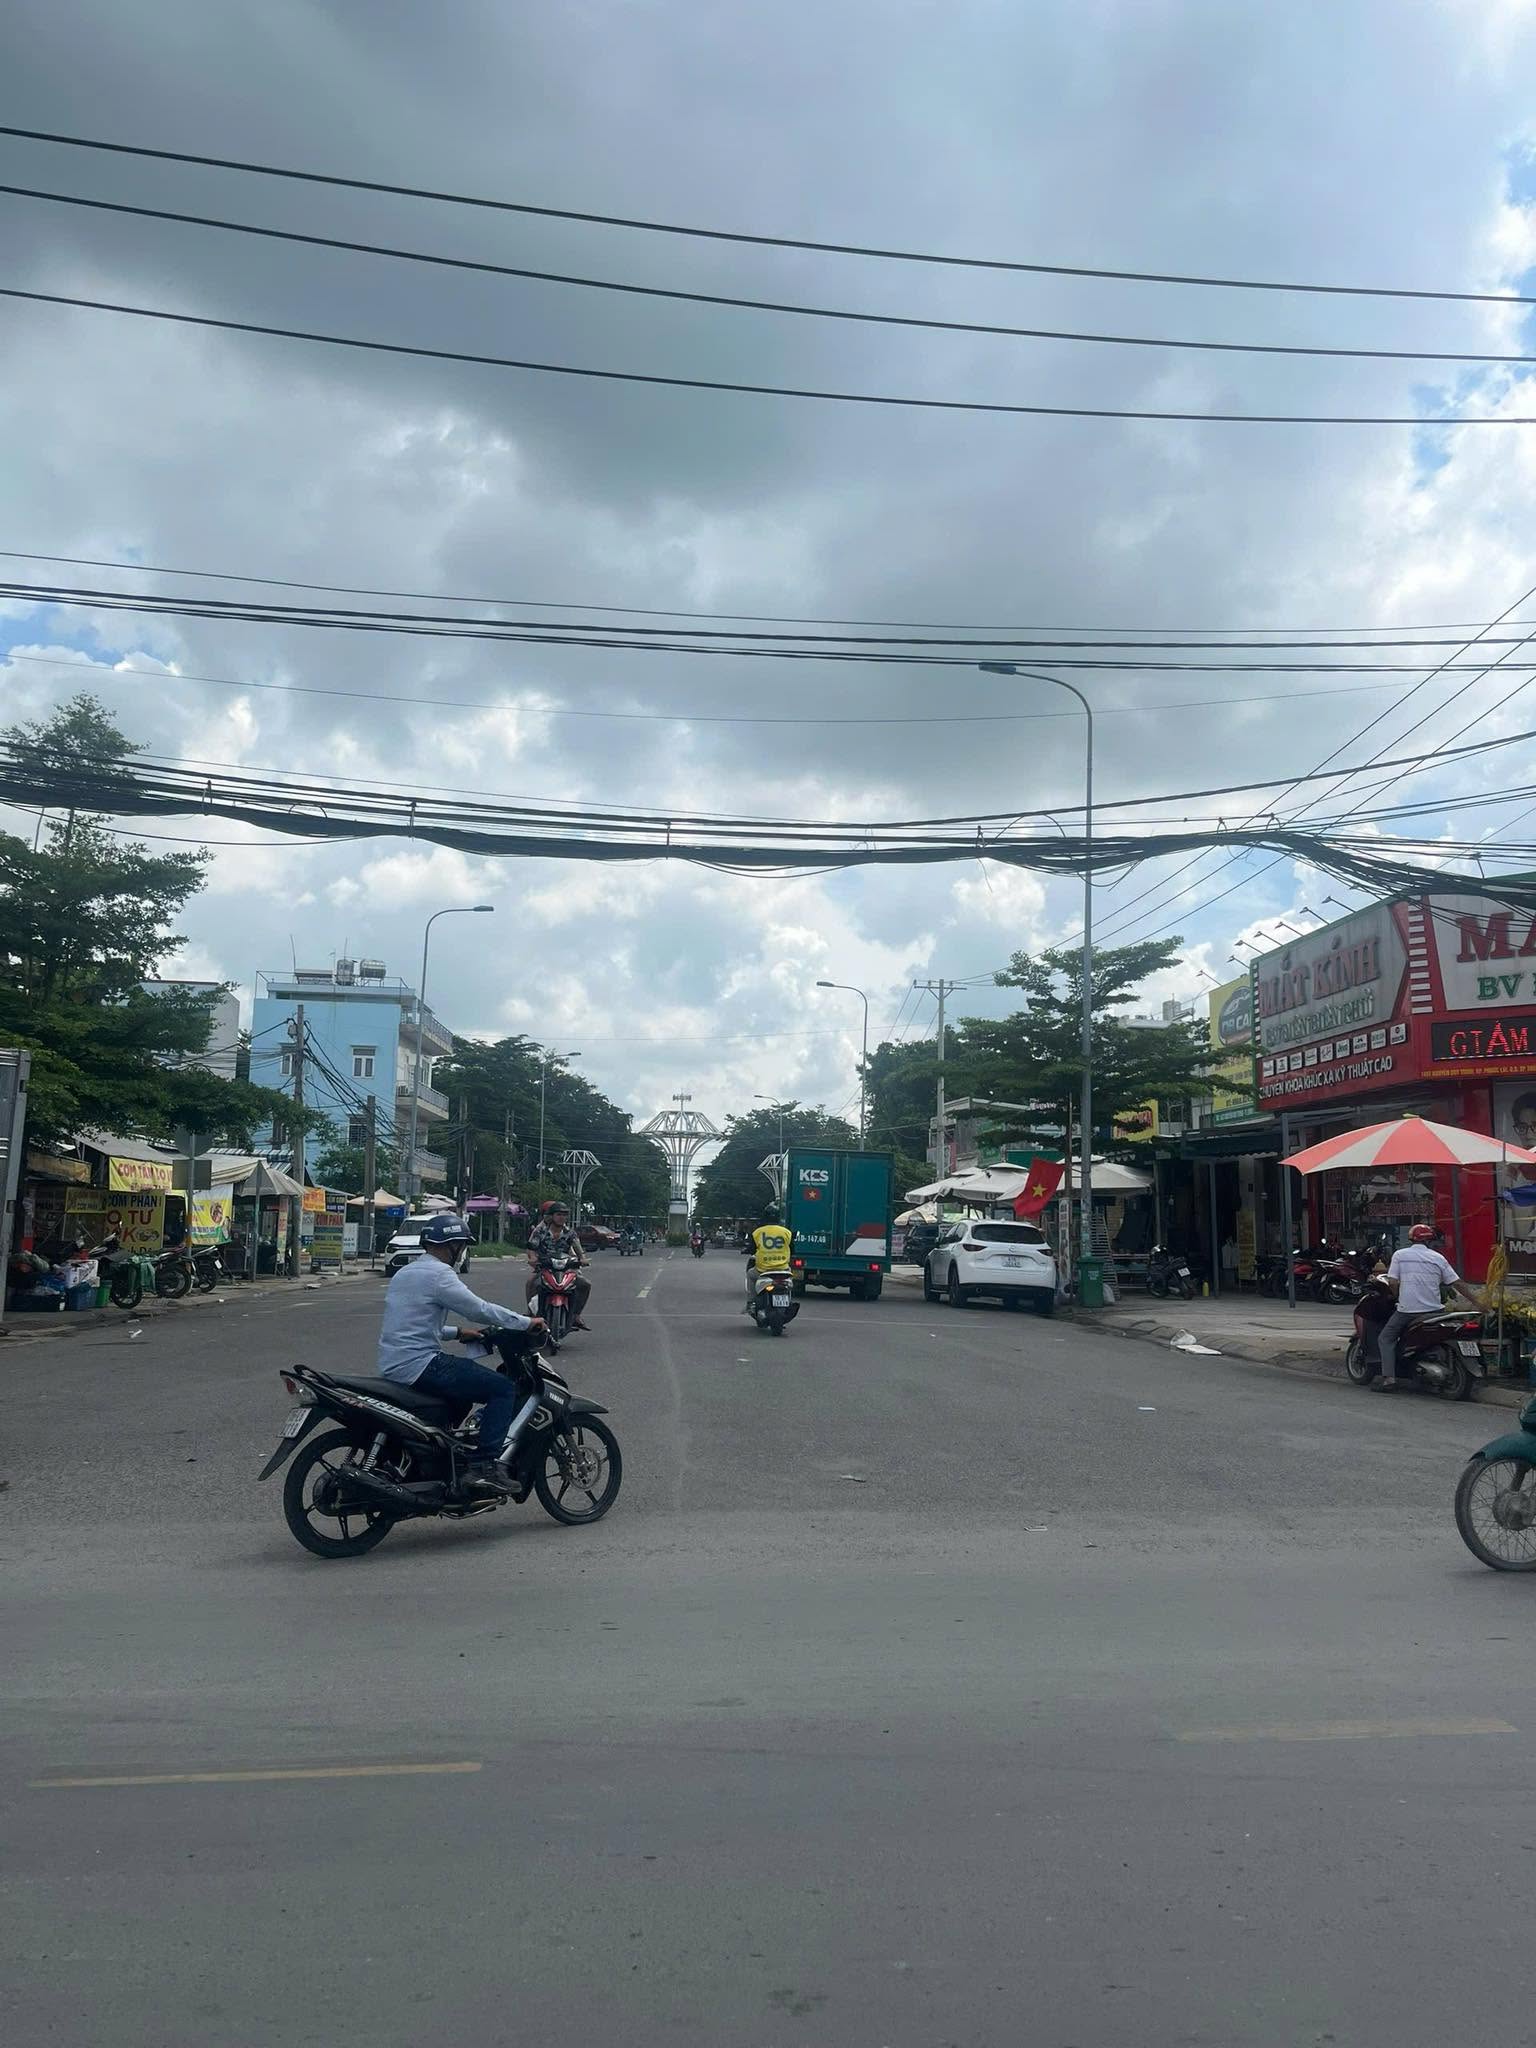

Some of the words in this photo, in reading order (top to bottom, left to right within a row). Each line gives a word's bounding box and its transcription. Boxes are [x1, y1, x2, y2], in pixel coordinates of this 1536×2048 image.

[1477, 974, 1524, 1001] BV
[1284, 1076, 1304, 1093] KHOA
[1374, 1055, 1393, 1073] CAO
[761, 1232, 785, 1249] be
